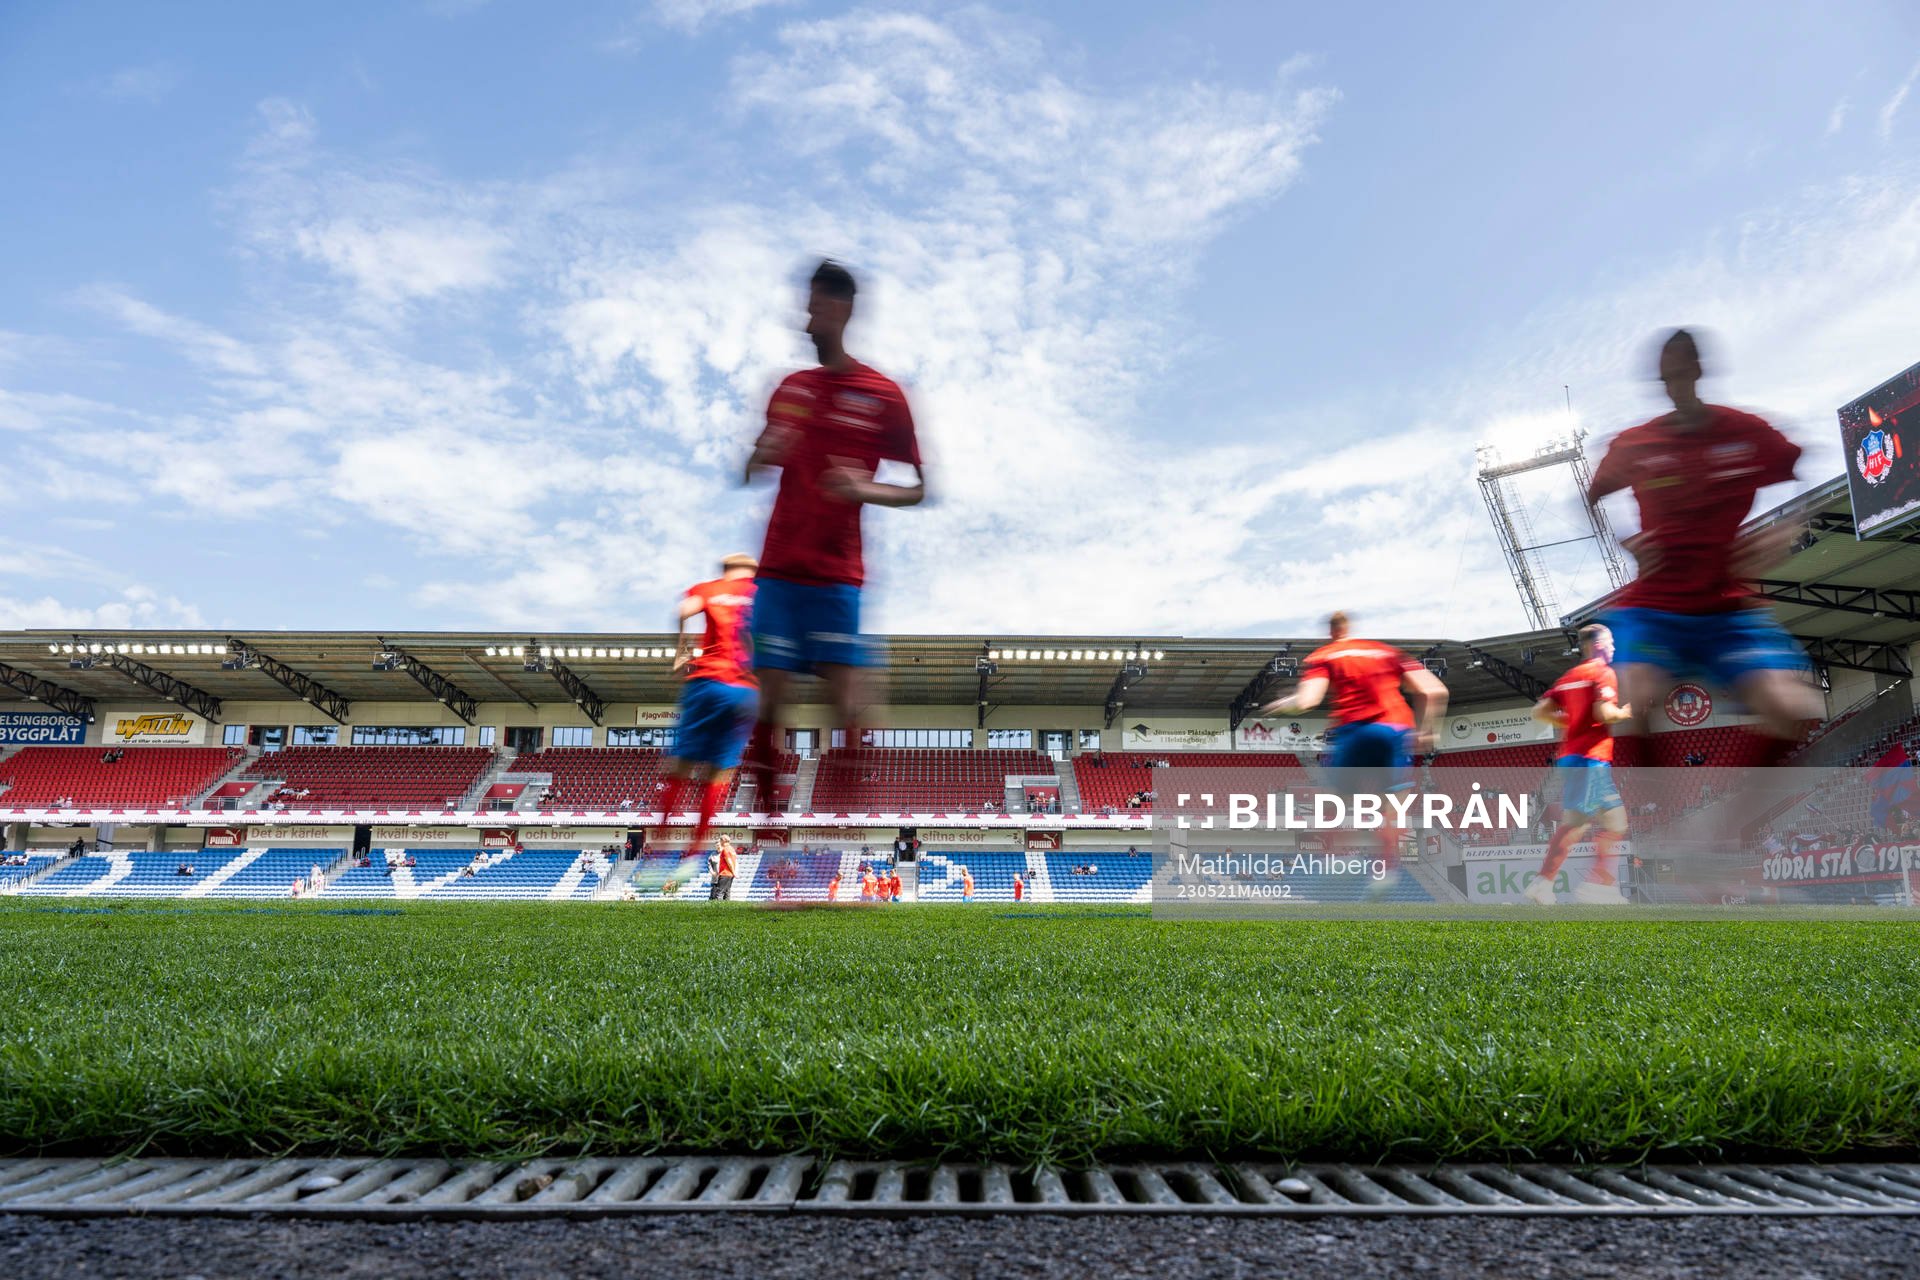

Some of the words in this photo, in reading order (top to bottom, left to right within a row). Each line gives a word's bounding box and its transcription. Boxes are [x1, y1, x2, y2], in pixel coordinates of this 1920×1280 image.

[1869, 454, 1881, 469] HIF
[0, 715, 81, 726] ELSINGBORGS
[0, 725, 80, 741] BYGGPLÅT
[115, 718, 194, 739] WALLIN
[1244, 722, 1274, 740] MAX
[1497, 732, 1521, 742] Hjerta
[251, 828, 276, 838] Det
[277, 828, 287, 838] är
[291, 828, 329, 838] kärlek
[376, 828, 408, 839] ikväll
[412, 828, 450, 840] syster
[525, 829, 548, 839] och
[551, 829, 576, 839] bror
[797, 829, 844, 842] hjärtan
[844, 830, 867, 841] och
[922, 830, 956, 841] slitna
[959, 830, 986, 842] skor
[210, 836, 234, 845] PUMA
[484, 837, 509, 846] PUMA
[1028, 840, 1052, 849] PUMA
[1516, 848, 1542, 856] BUSS
[1762, 853, 1815, 881] SÖDRA
[1820, 846, 1852, 878] STÅ
